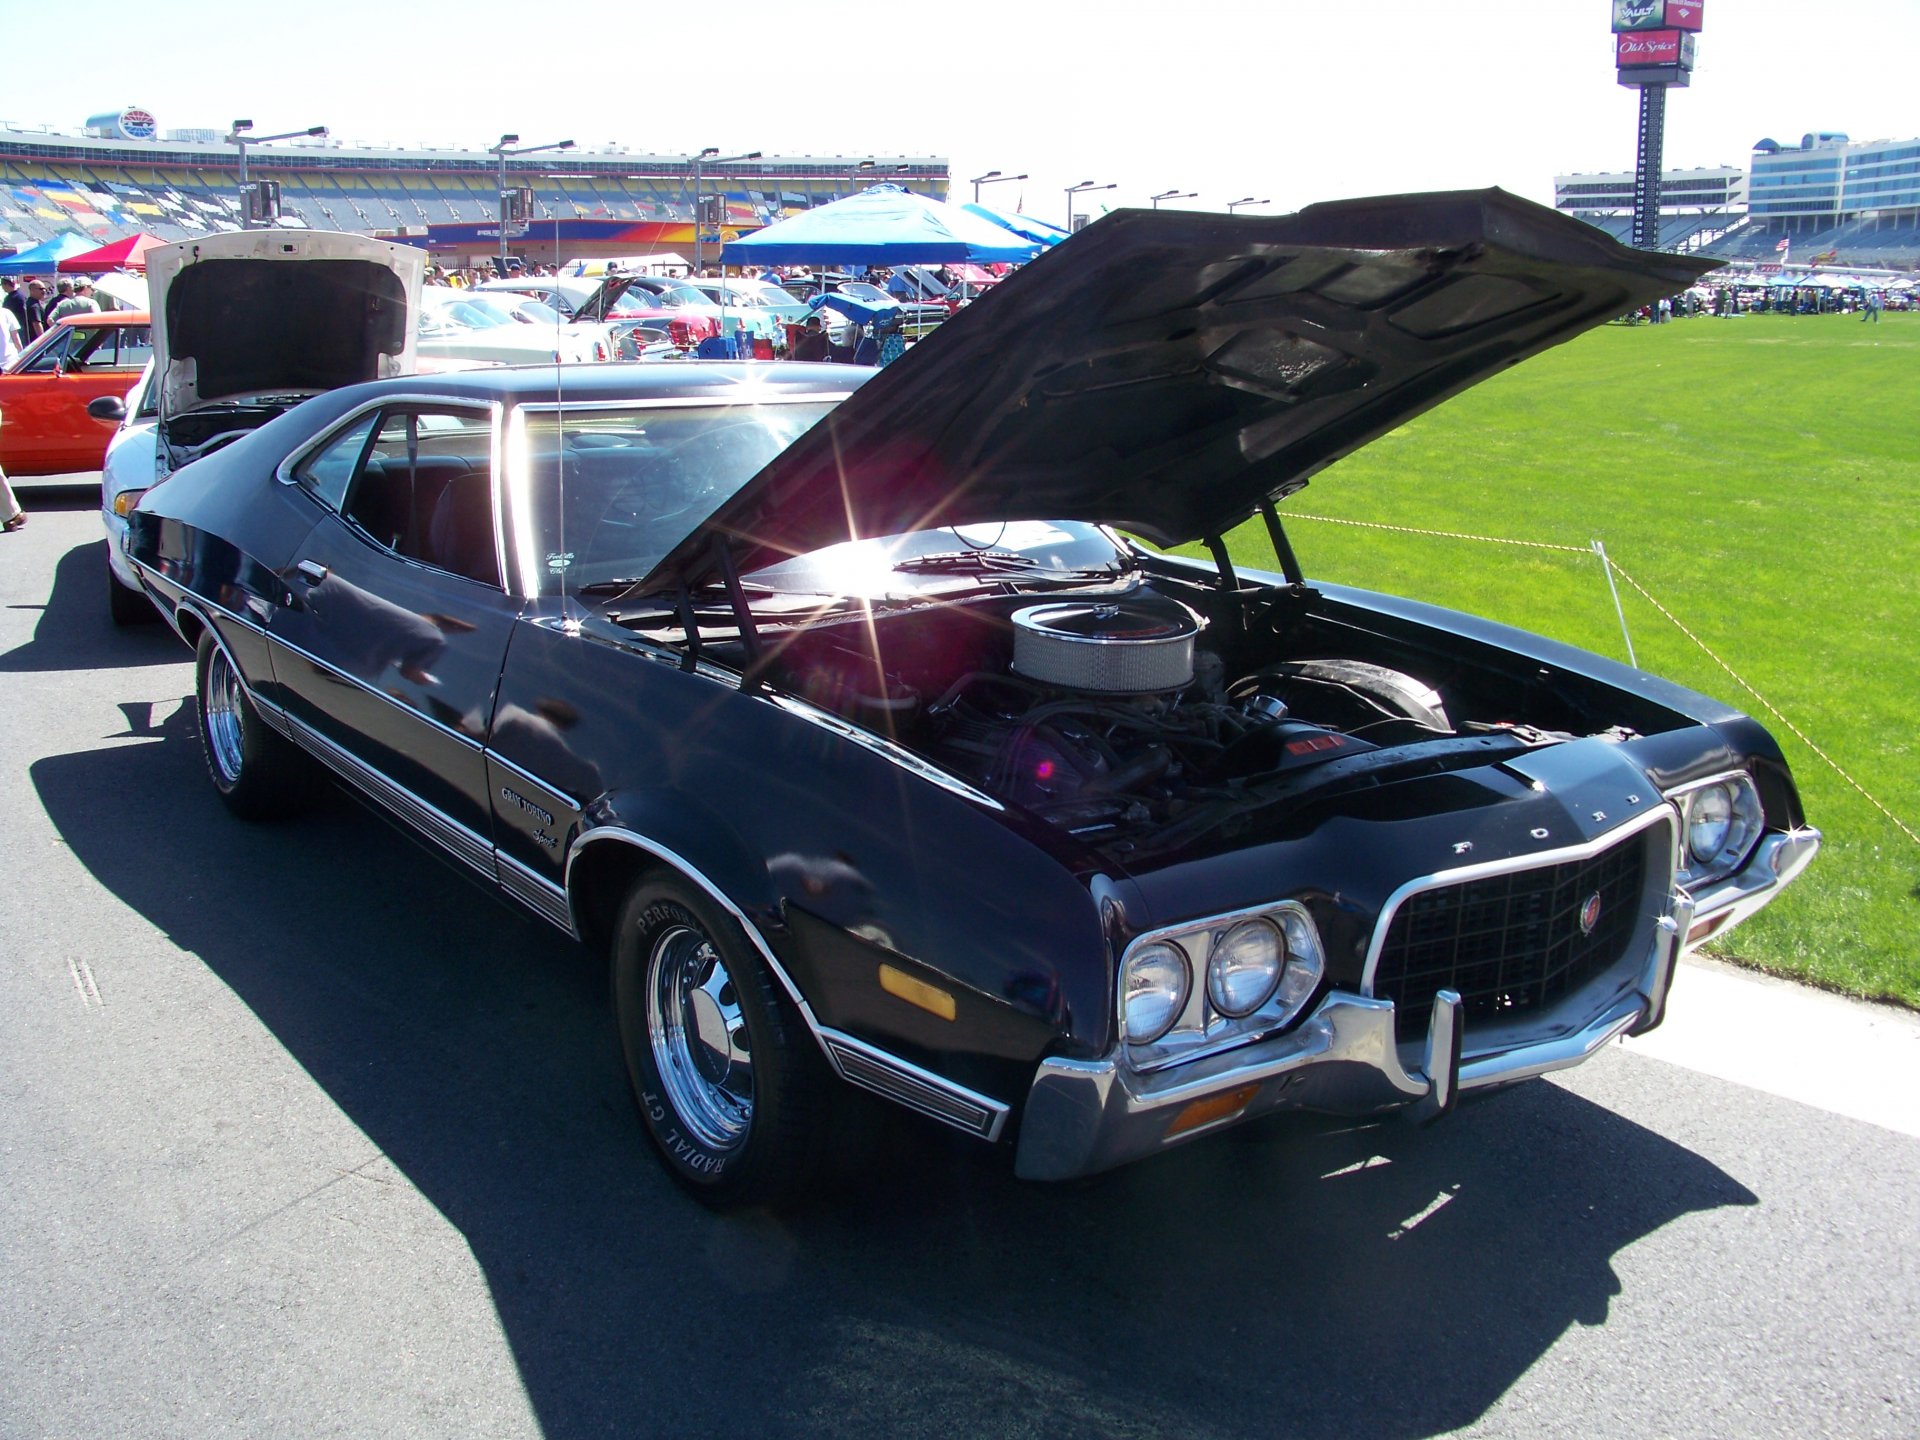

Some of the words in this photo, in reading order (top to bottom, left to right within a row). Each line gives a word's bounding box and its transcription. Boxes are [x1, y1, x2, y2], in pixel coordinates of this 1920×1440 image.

[1621, 6, 1655, 19] VAULT
[1619, 41, 1643, 54] Old
[1643, 40, 1674, 54] Spice
[502, 788, 521, 807] GRAN
[521, 801, 551, 826] TORINO
[532, 829, 558, 849] Sport
[1451, 794, 1640, 856] FORD
[641, 1091, 665, 1122] GT
[665, 1128, 727, 1174] RADIAL
